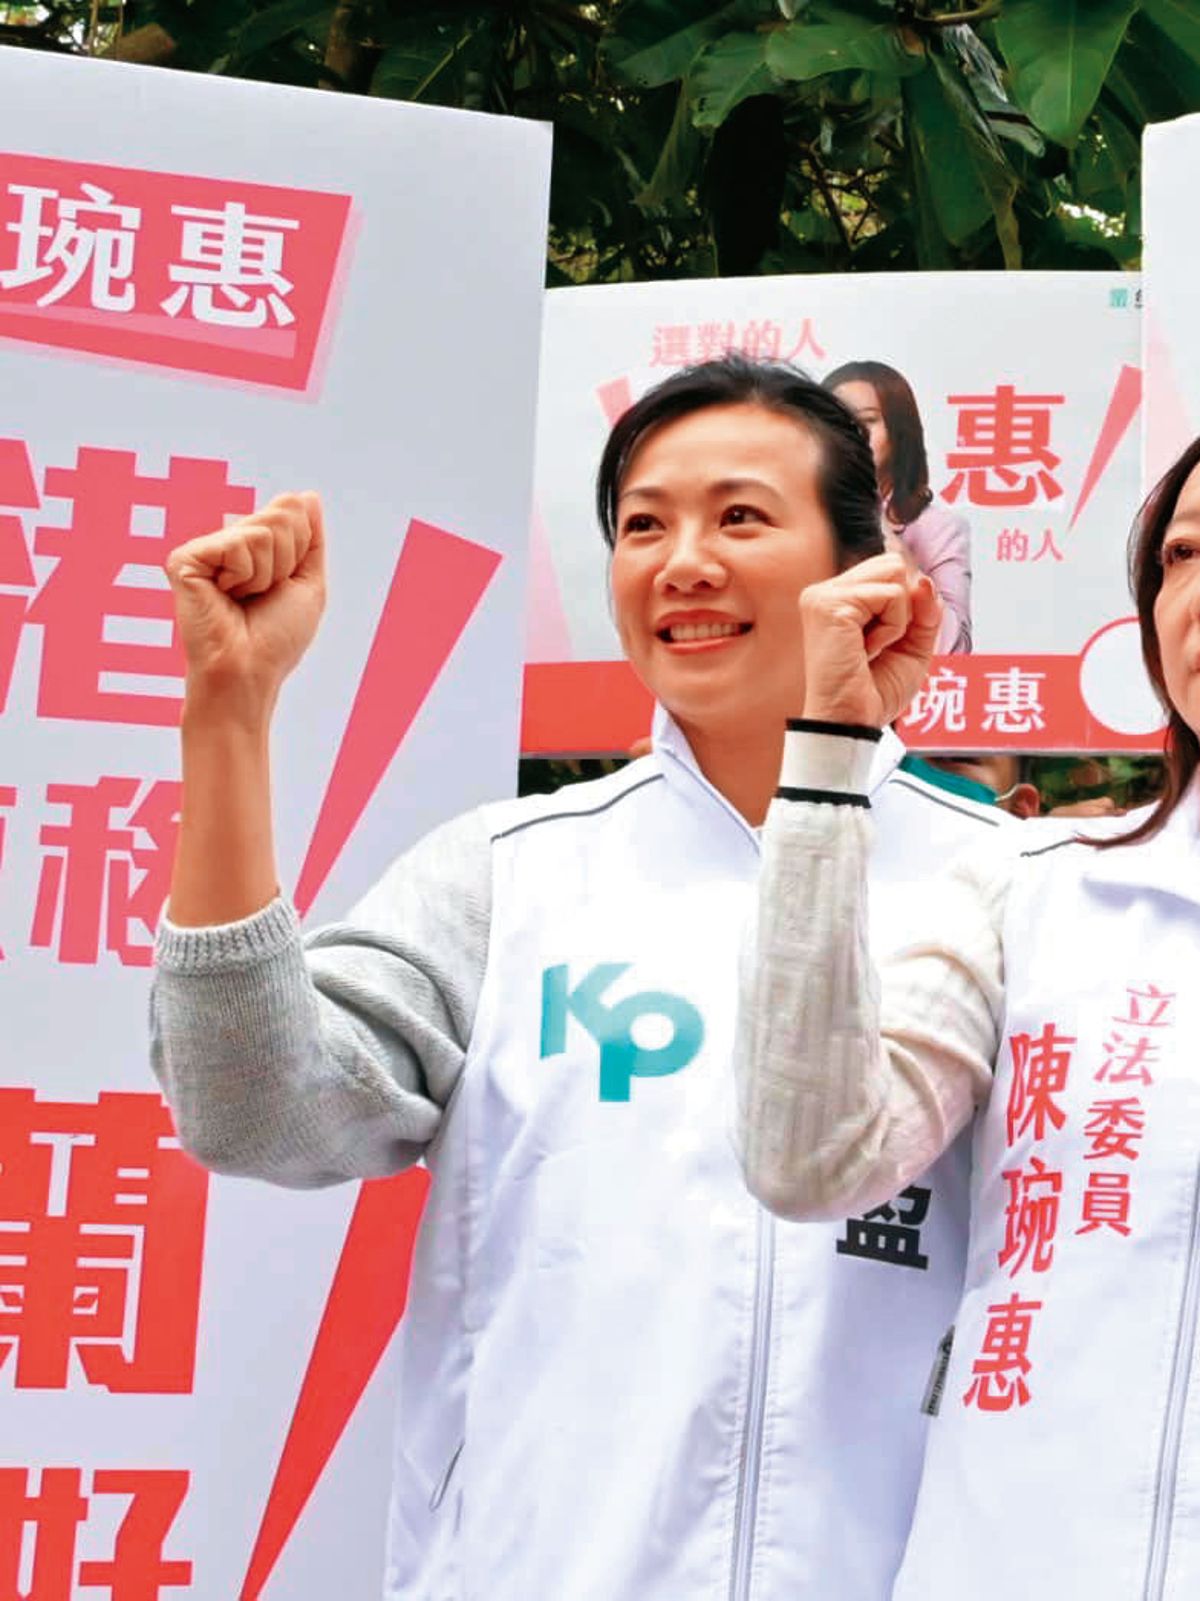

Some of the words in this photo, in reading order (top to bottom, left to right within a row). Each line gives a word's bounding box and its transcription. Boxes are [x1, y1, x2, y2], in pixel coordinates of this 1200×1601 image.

[0, 183, 299, 328] 琬惠
[649, 317, 826, 368] 選對的人
[940, 385, 1065, 505] 惠
[997, 527, 1064, 562] 的人
[902, 666, 1047, 734] 琬惠
[0, 776, 184, 967] 移
[1074, 984, 1177, 1237] 立法委員
[963, 1022, 1078, 1412] 陳琬惠
